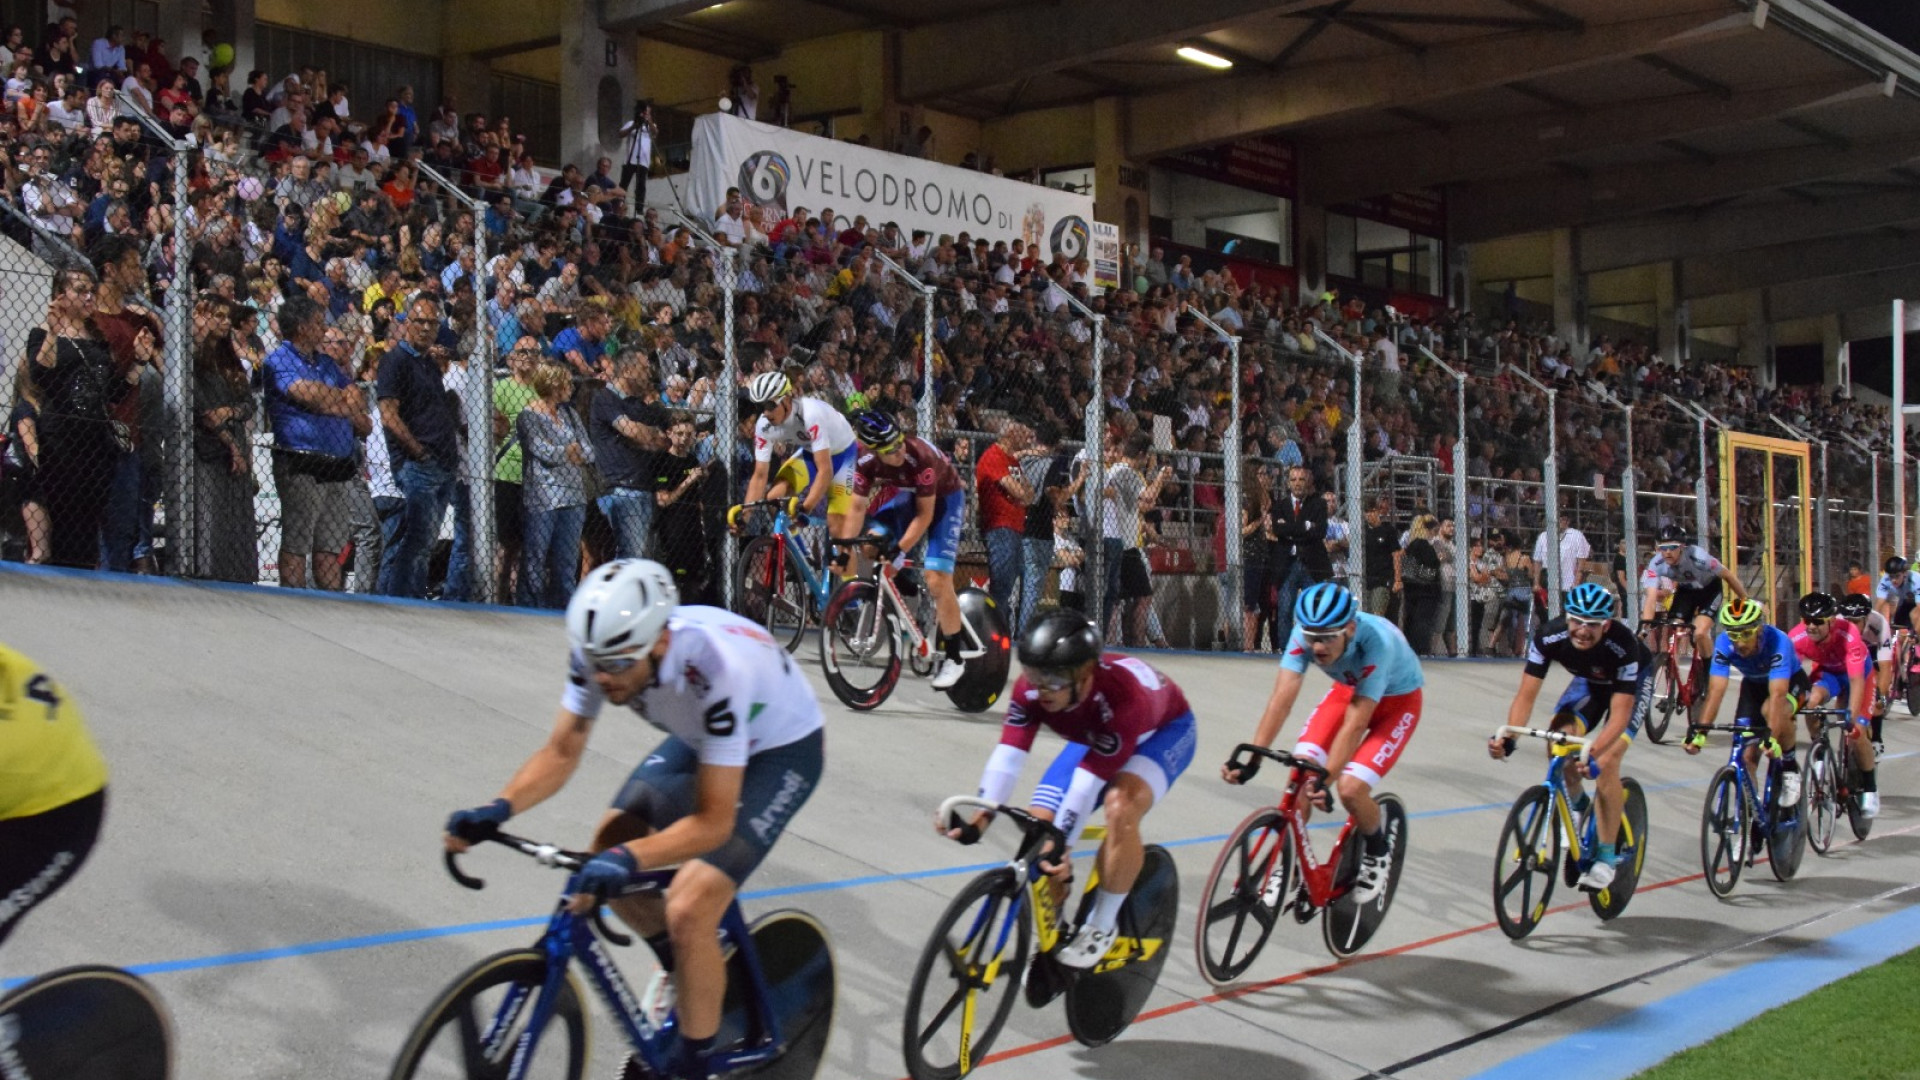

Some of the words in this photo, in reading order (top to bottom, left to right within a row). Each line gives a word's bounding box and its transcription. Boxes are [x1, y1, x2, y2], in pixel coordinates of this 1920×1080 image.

[752, 155, 776, 201] 6
[796, 154, 992, 226] VELODROMO
[998, 211, 1013, 231] DI
[1061, 219, 1080, 260] 6
[1631, 676, 1655, 729] UKRAINE
[1372, 711, 1415, 768] POLSKA
